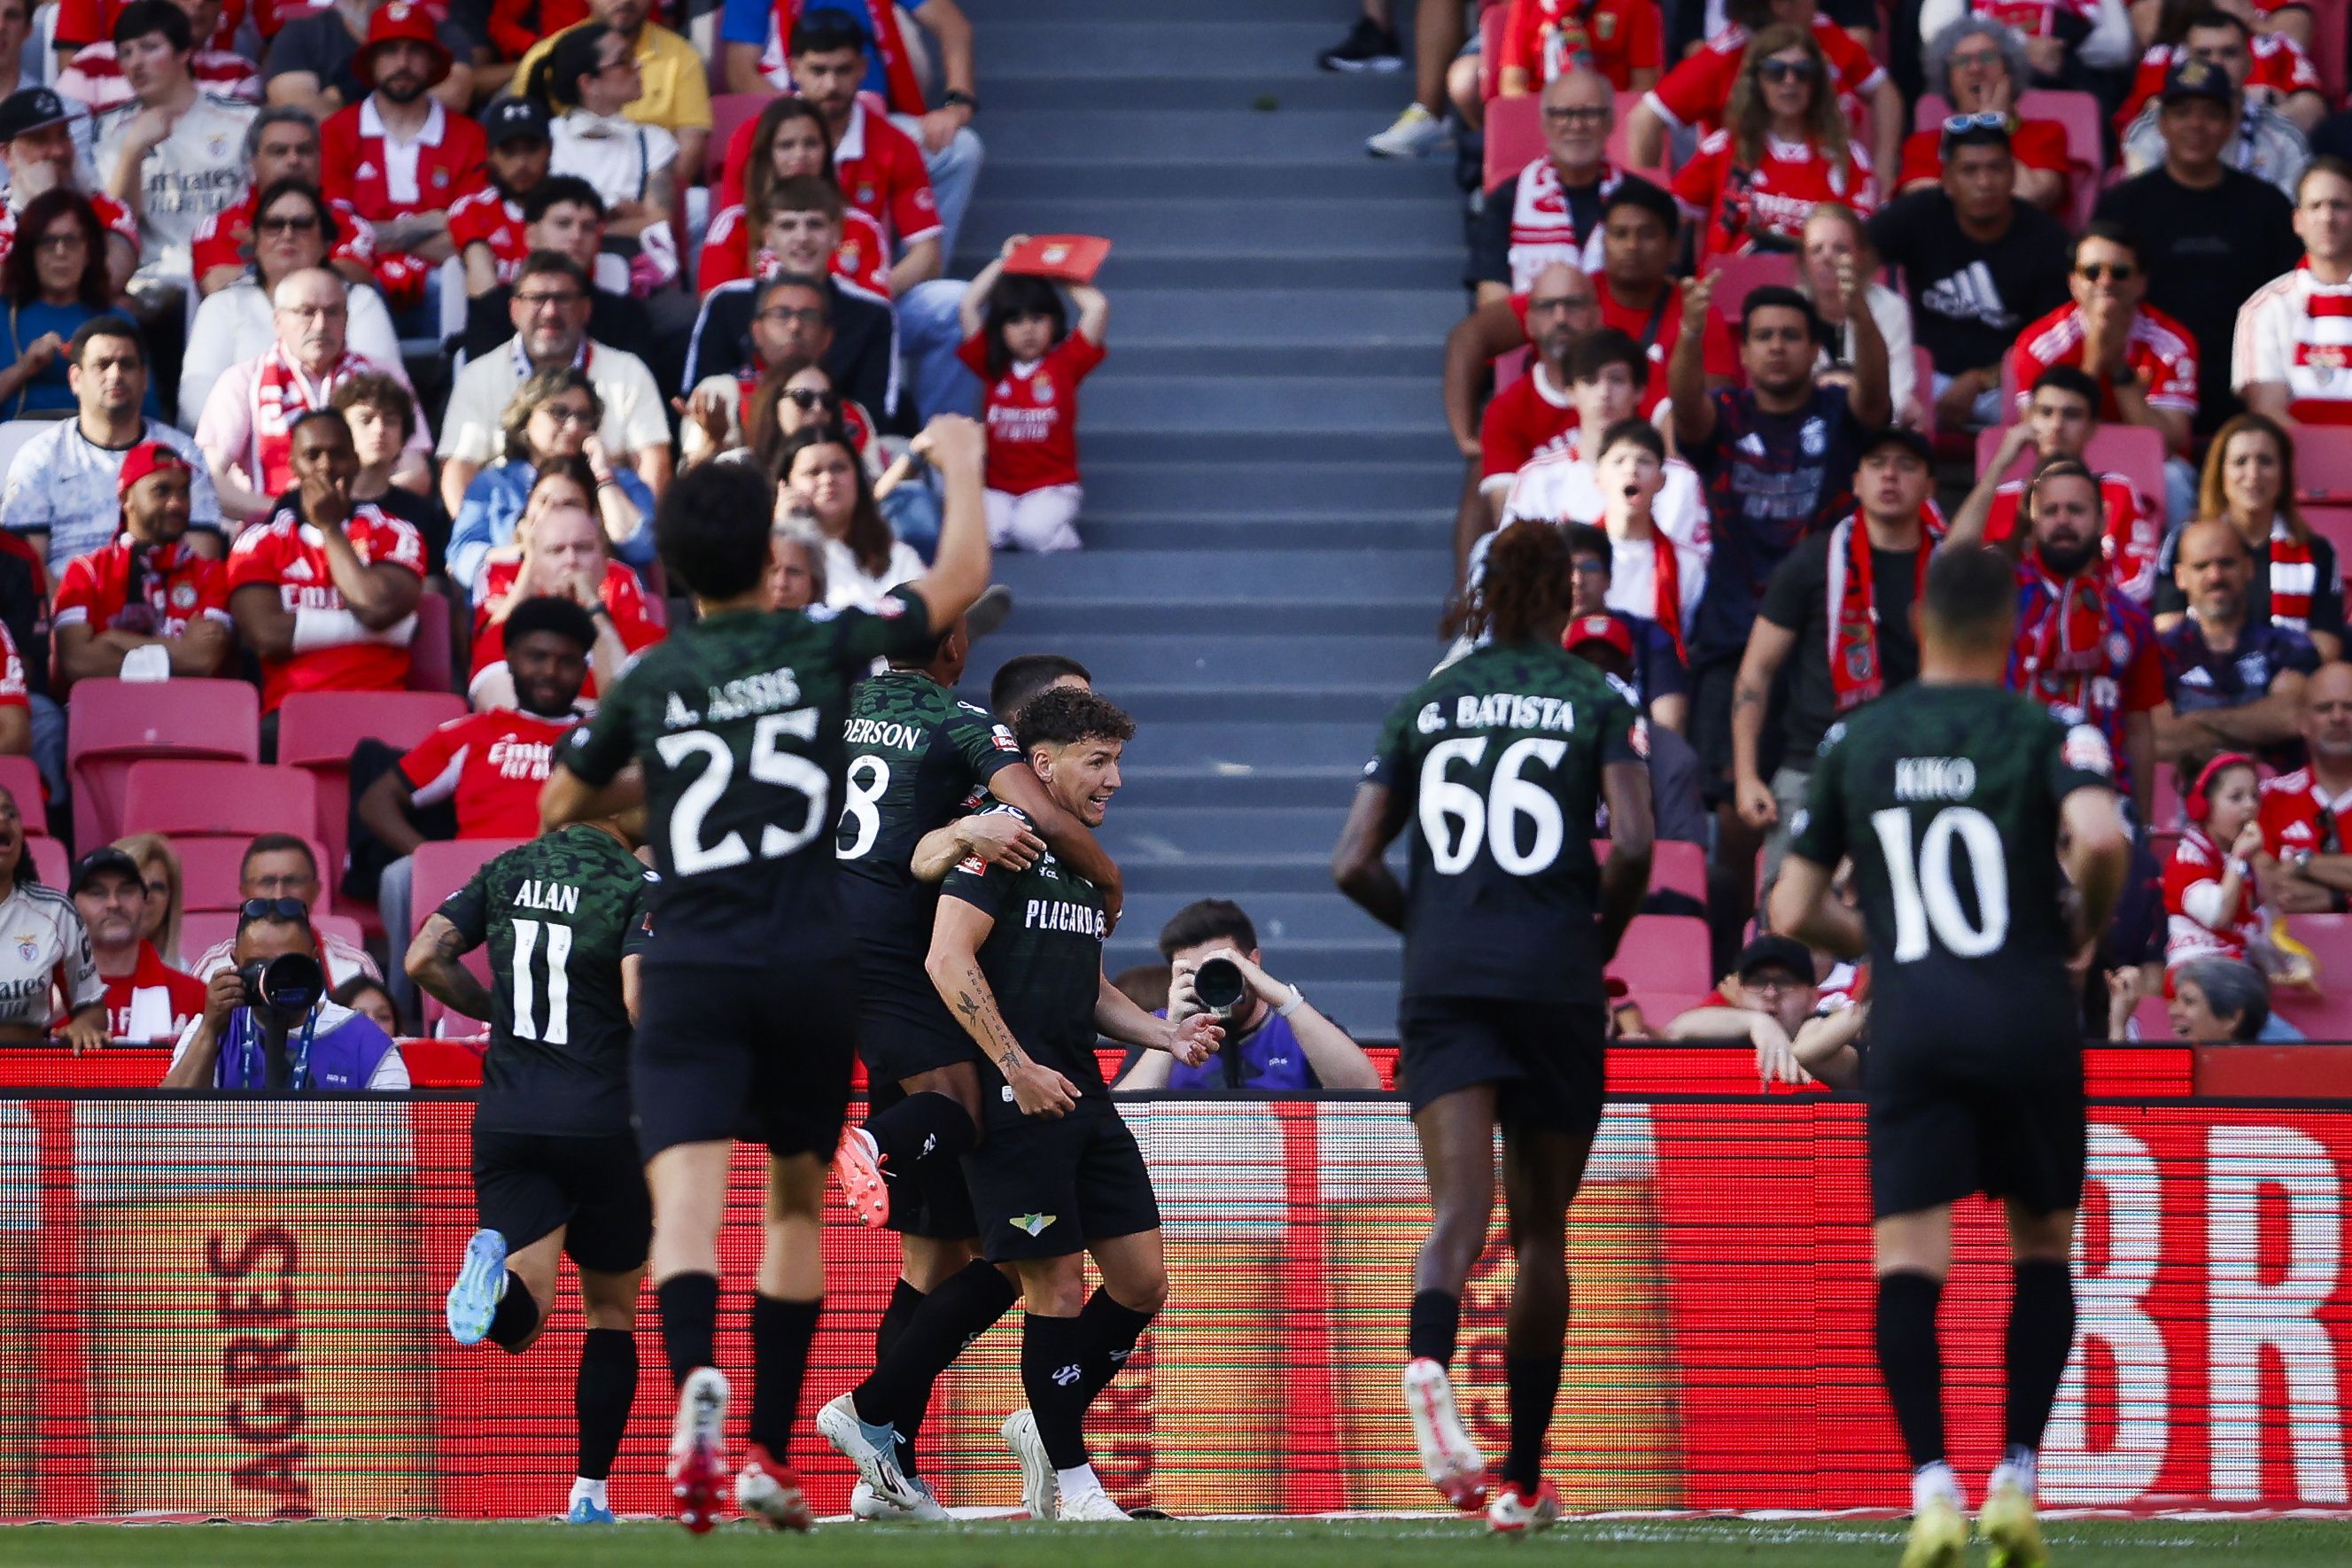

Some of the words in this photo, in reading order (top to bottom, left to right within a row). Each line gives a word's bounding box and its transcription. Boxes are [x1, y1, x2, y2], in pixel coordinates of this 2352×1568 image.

[708, 667, 801, 722] ASSIS
[842, 718, 921, 751] DERSON
[1455, 693, 1574, 733] BATISTA
[655, 707, 830, 876] 25
[835, 755, 890, 860] 8
[1419, 736, 1568, 876] 66
[513, 880, 579, 914] ALAN
[1870, 806, 2010, 963] 10
[510, 918, 572, 1044] 11
[206, 1225, 313, 1516] AGRES
